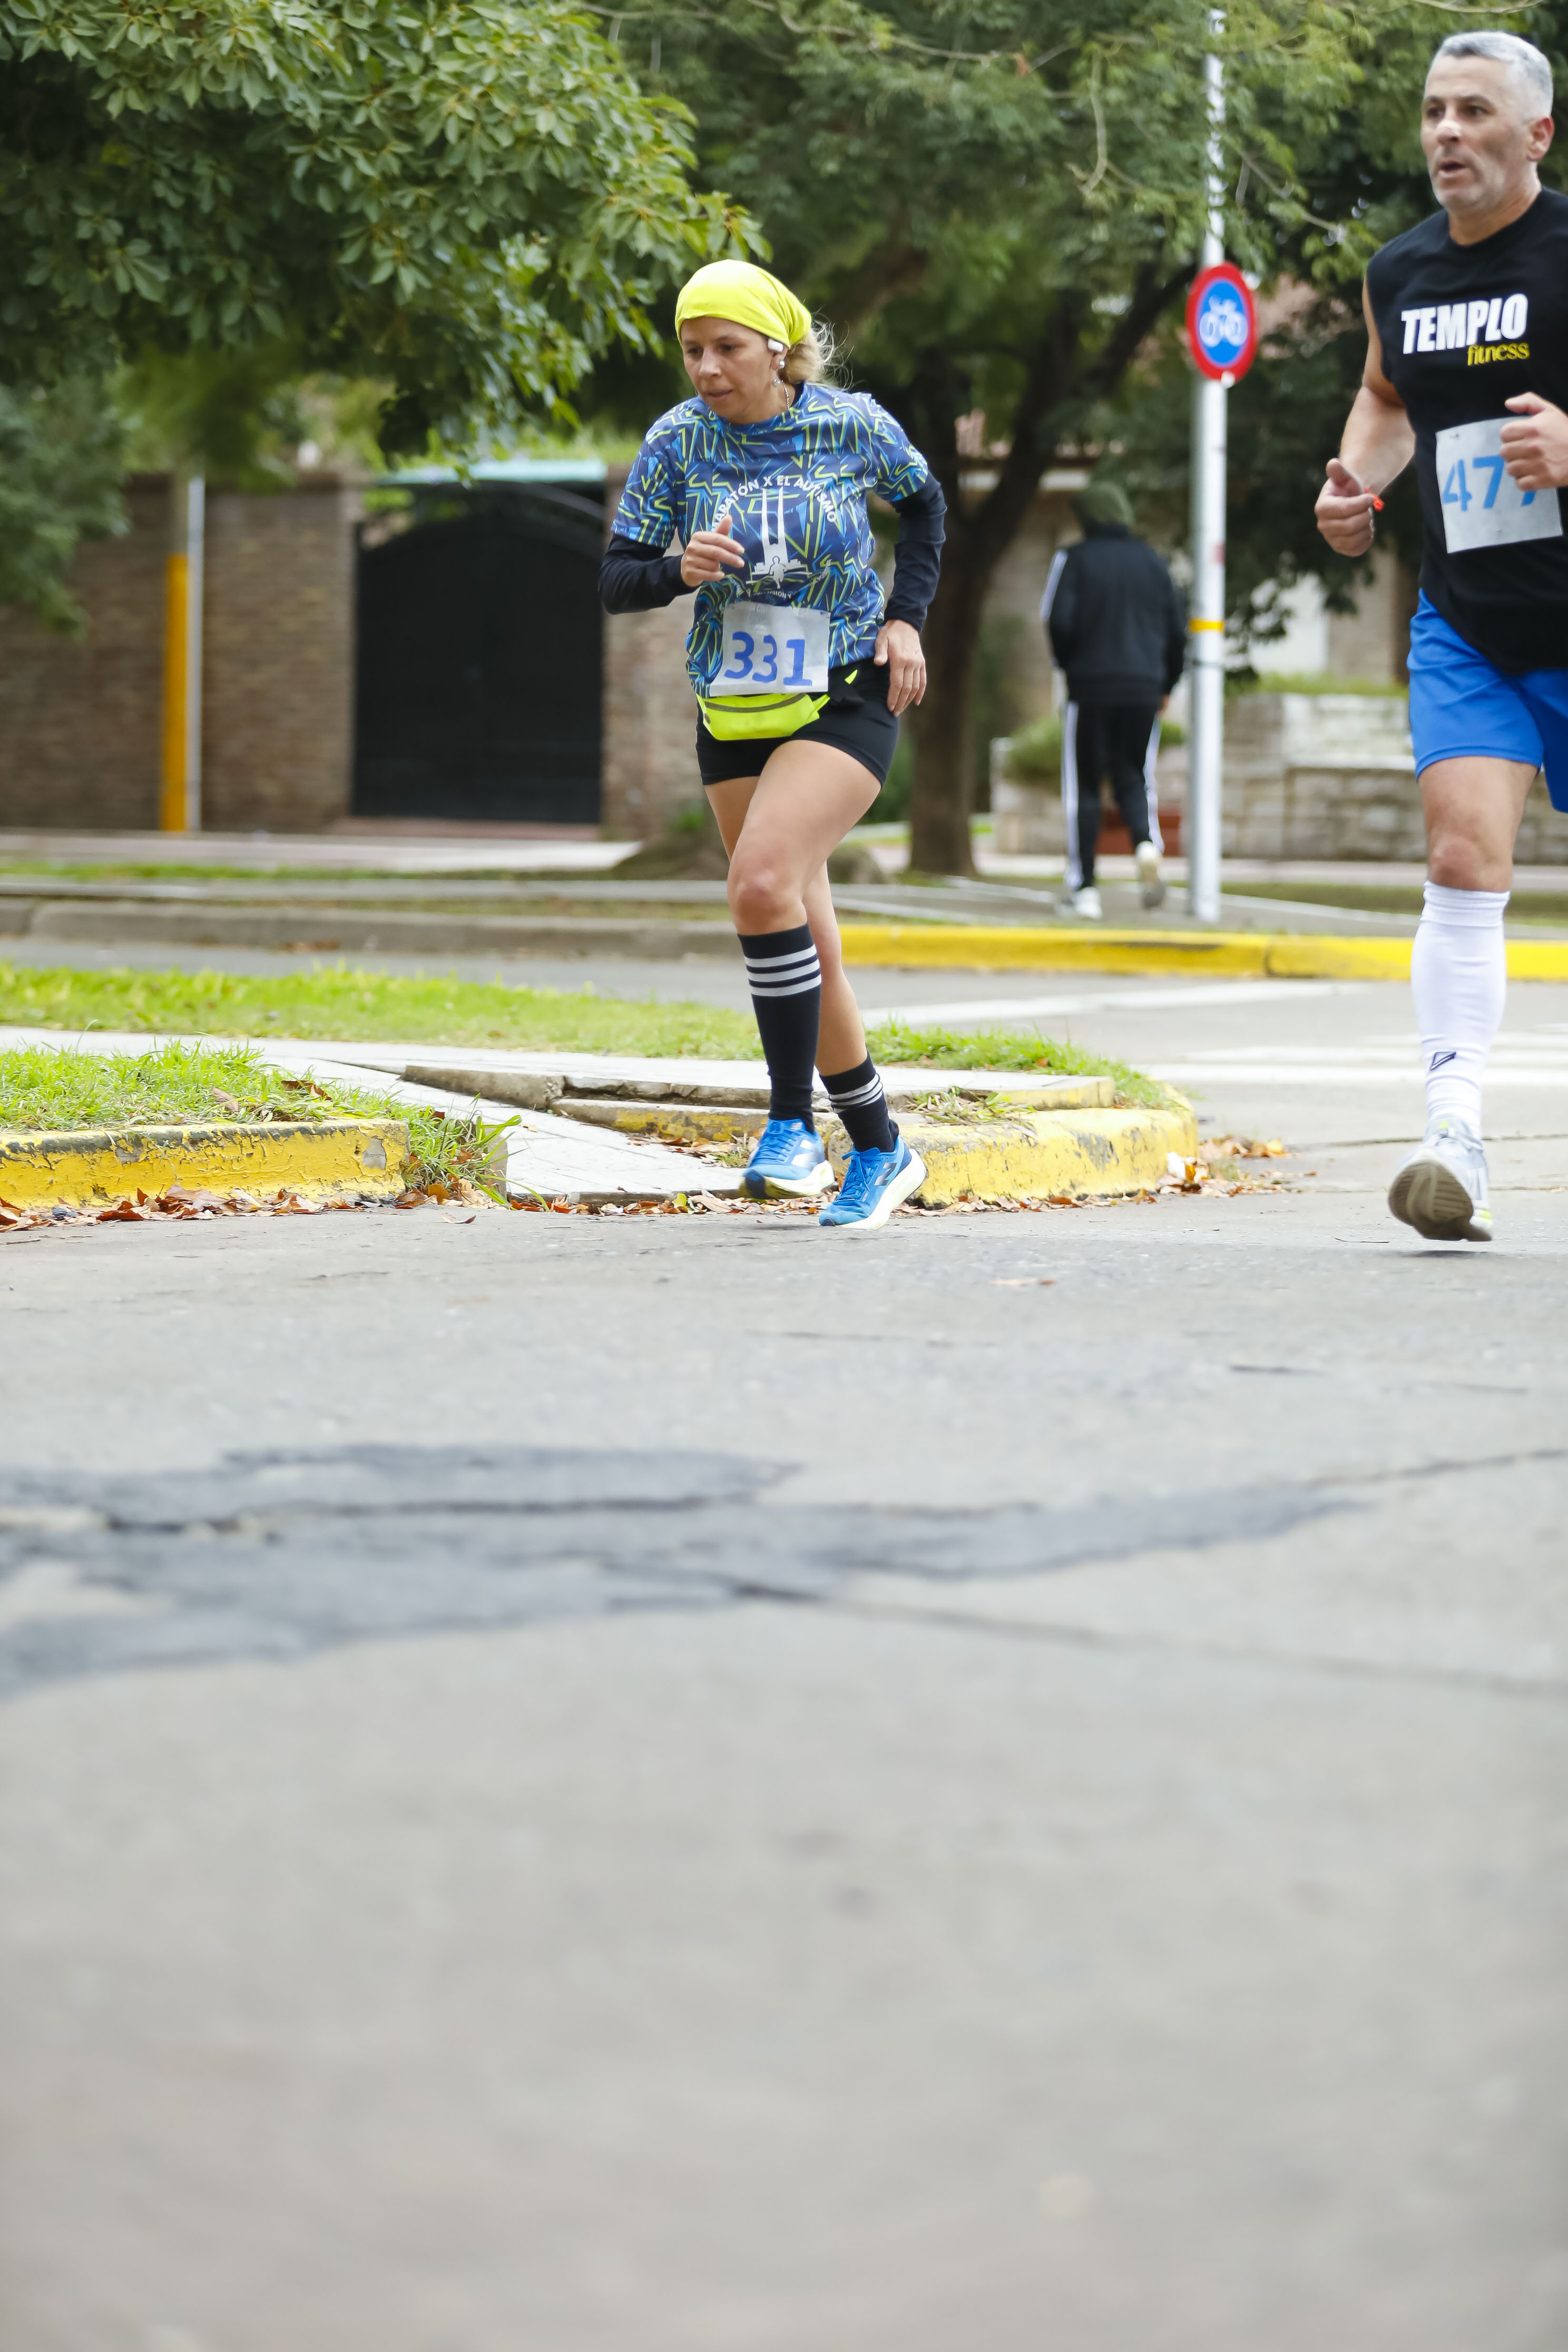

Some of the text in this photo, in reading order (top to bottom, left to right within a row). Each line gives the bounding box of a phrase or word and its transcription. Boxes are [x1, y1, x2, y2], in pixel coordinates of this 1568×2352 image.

[1401, 293, 1528, 354] TEMPLO
[1467, 343, 1530, 366] fitness
[763, 475, 773, 487] X
[777, 475, 790, 486] EL
[793, 478, 837, 523] AUTISMO
[1443, 455, 1537, 512] 47
[724, 631, 812, 686] 331
